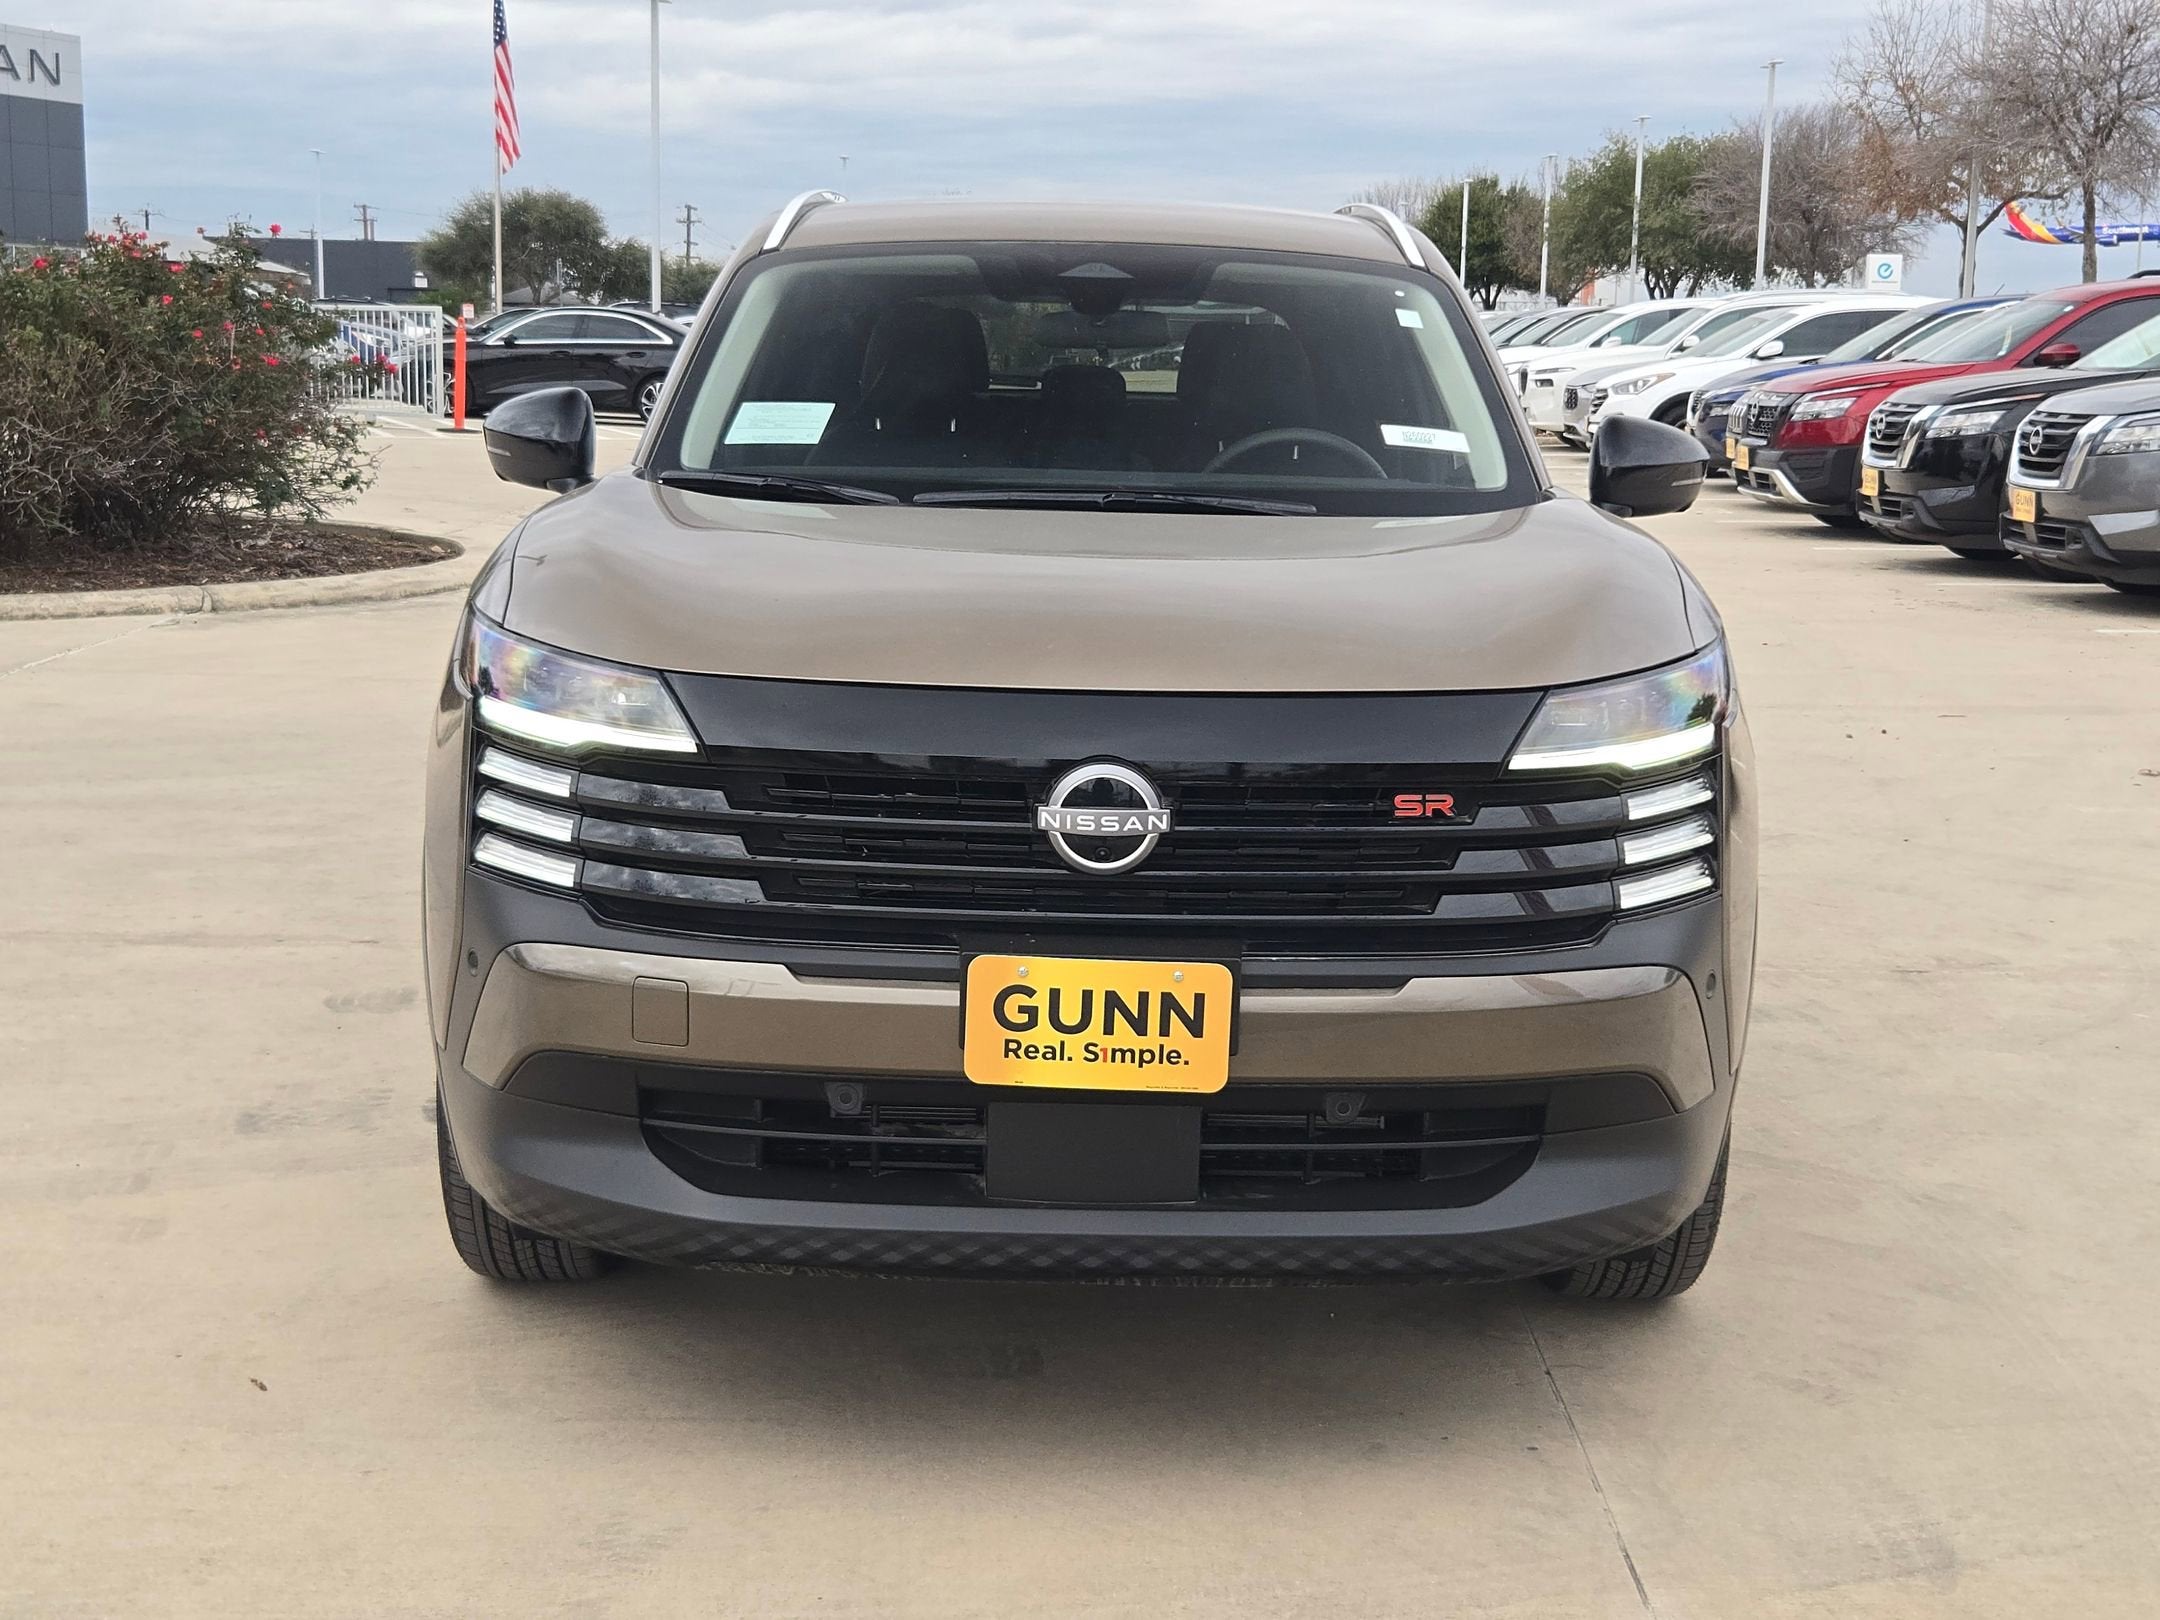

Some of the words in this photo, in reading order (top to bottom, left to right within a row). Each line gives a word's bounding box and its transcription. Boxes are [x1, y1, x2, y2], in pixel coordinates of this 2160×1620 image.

[1394, 794, 1455, 817] SR
[1040, 811, 1168, 832] NISSAN
[992, 984, 1206, 1039] GUNN
[1003, 1038, 1073, 1062] Real.
[1083, 1042, 1190, 1068] S1mple.
